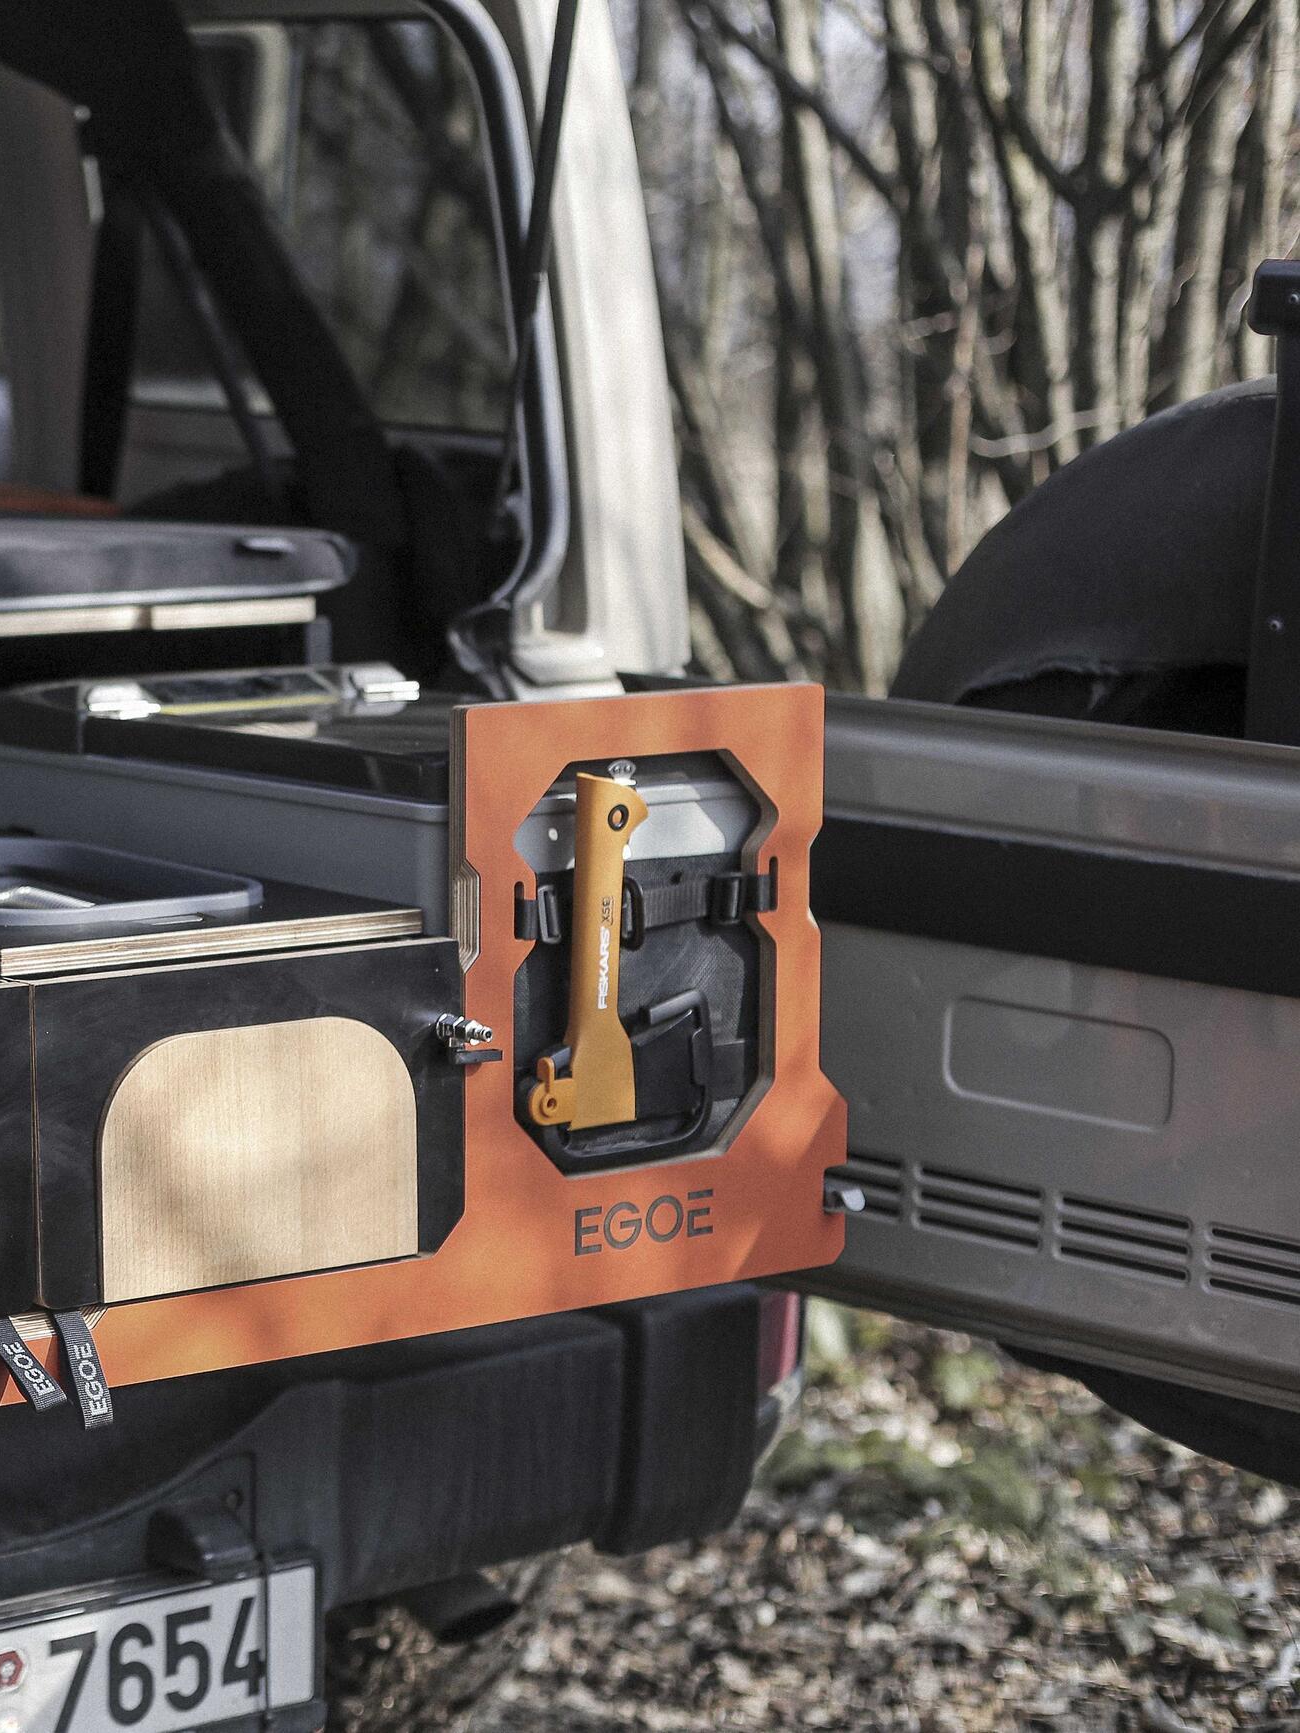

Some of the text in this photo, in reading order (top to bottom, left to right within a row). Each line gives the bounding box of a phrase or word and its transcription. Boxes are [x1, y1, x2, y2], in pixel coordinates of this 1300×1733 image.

[597, 927, 611, 1010] FISKARS
[574, 1188, 714, 1257] EGOE
[2, 1341, 56, 1397] EGOE
[73, 1342, 109, 1417] EGOE
[49, 1596, 267, 1733] 7654
